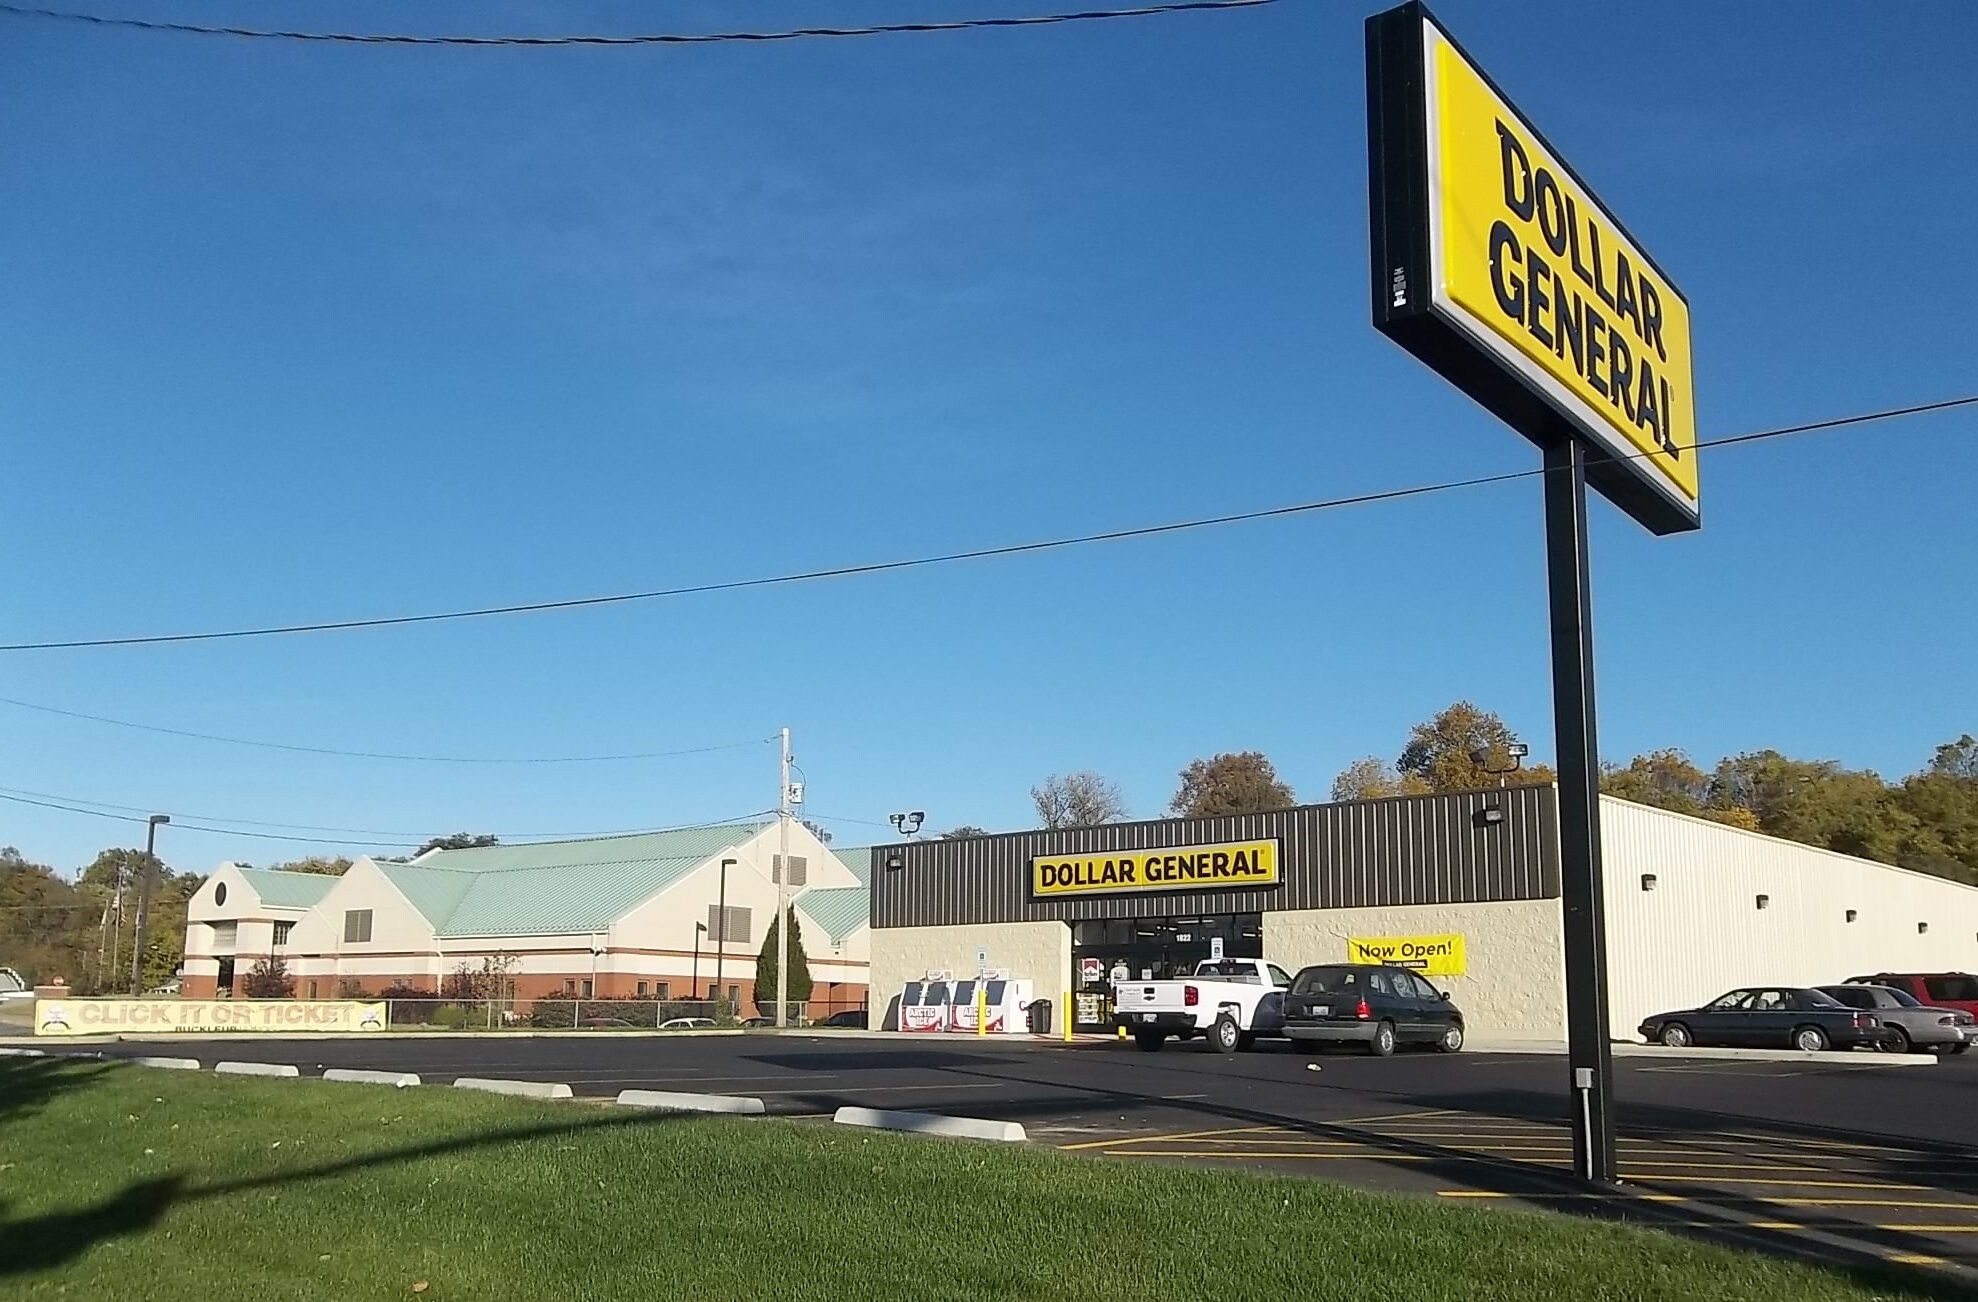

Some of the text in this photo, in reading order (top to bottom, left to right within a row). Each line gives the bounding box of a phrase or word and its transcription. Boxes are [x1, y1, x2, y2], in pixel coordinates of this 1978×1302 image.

[1495, 117, 1666, 363] DOLLAR
[1489, 220, 1679, 460] GENERAL
[1040, 850, 1267, 887] DOLLAR GENERAL
[1176, 934, 1191, 942] 1822
[1359, 940, 1452, 959] Now Open!
[79, 1004, 172, 1025] CLICK
[180, 1004, 206, 1025] IT
[210, 1004, 255, 1025] OR
[259, 1004, 355, 1025] TICKET
[909, 1007, 935, 1017] ARCTIC
[915, 1017, 929, 1026] ICE
[963, 1007, 991, 1017] ARCC
